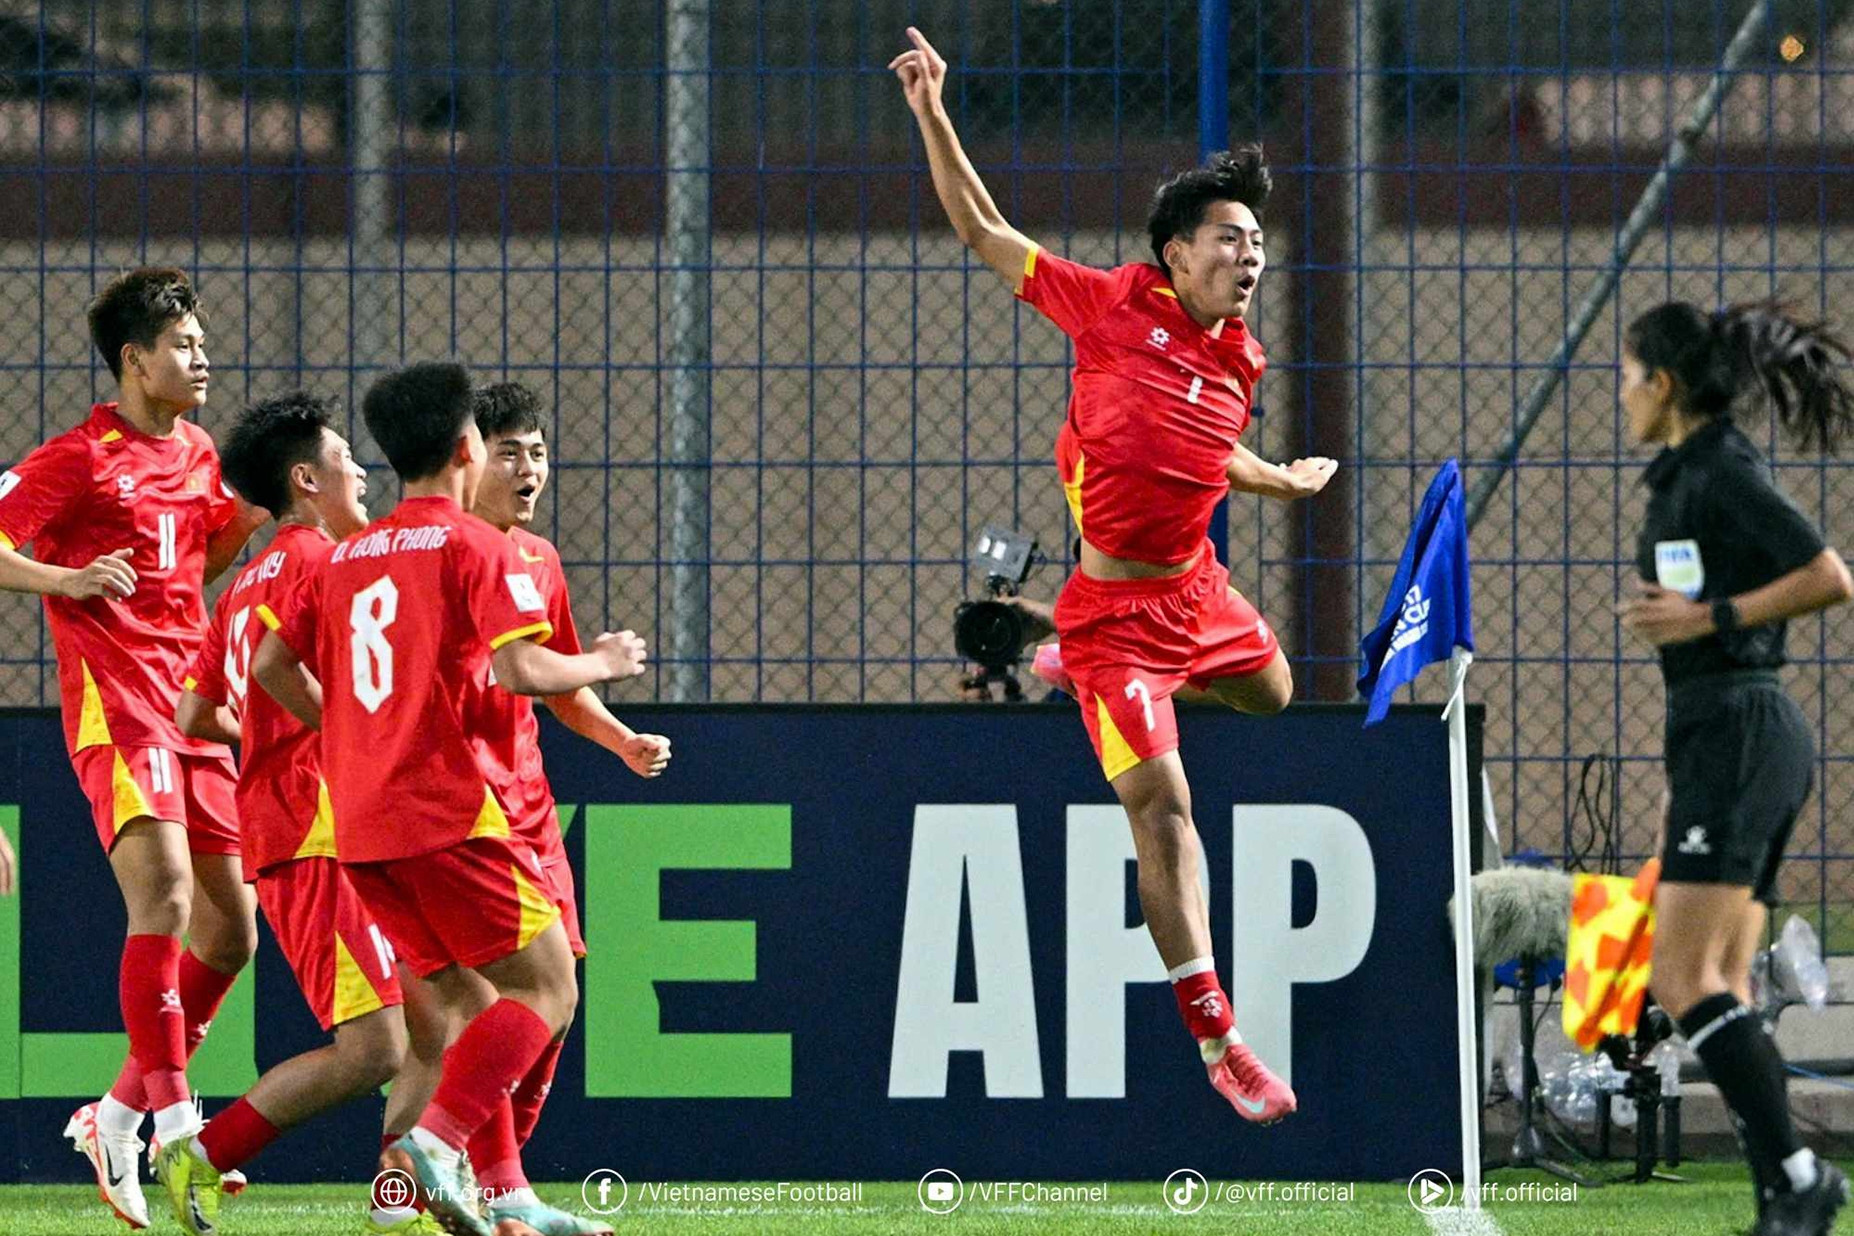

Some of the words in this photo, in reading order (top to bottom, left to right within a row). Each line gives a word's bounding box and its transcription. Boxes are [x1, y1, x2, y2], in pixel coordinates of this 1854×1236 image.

[158, 513, 176, 570] 11
[392, 525, 453, 552] PHONG
[350, 574, 399, 714] 8
[1124, 678, 1155, 732] 7
[148, 747, 173, 794] 11
[888, 804, 1377, 1098] APP
